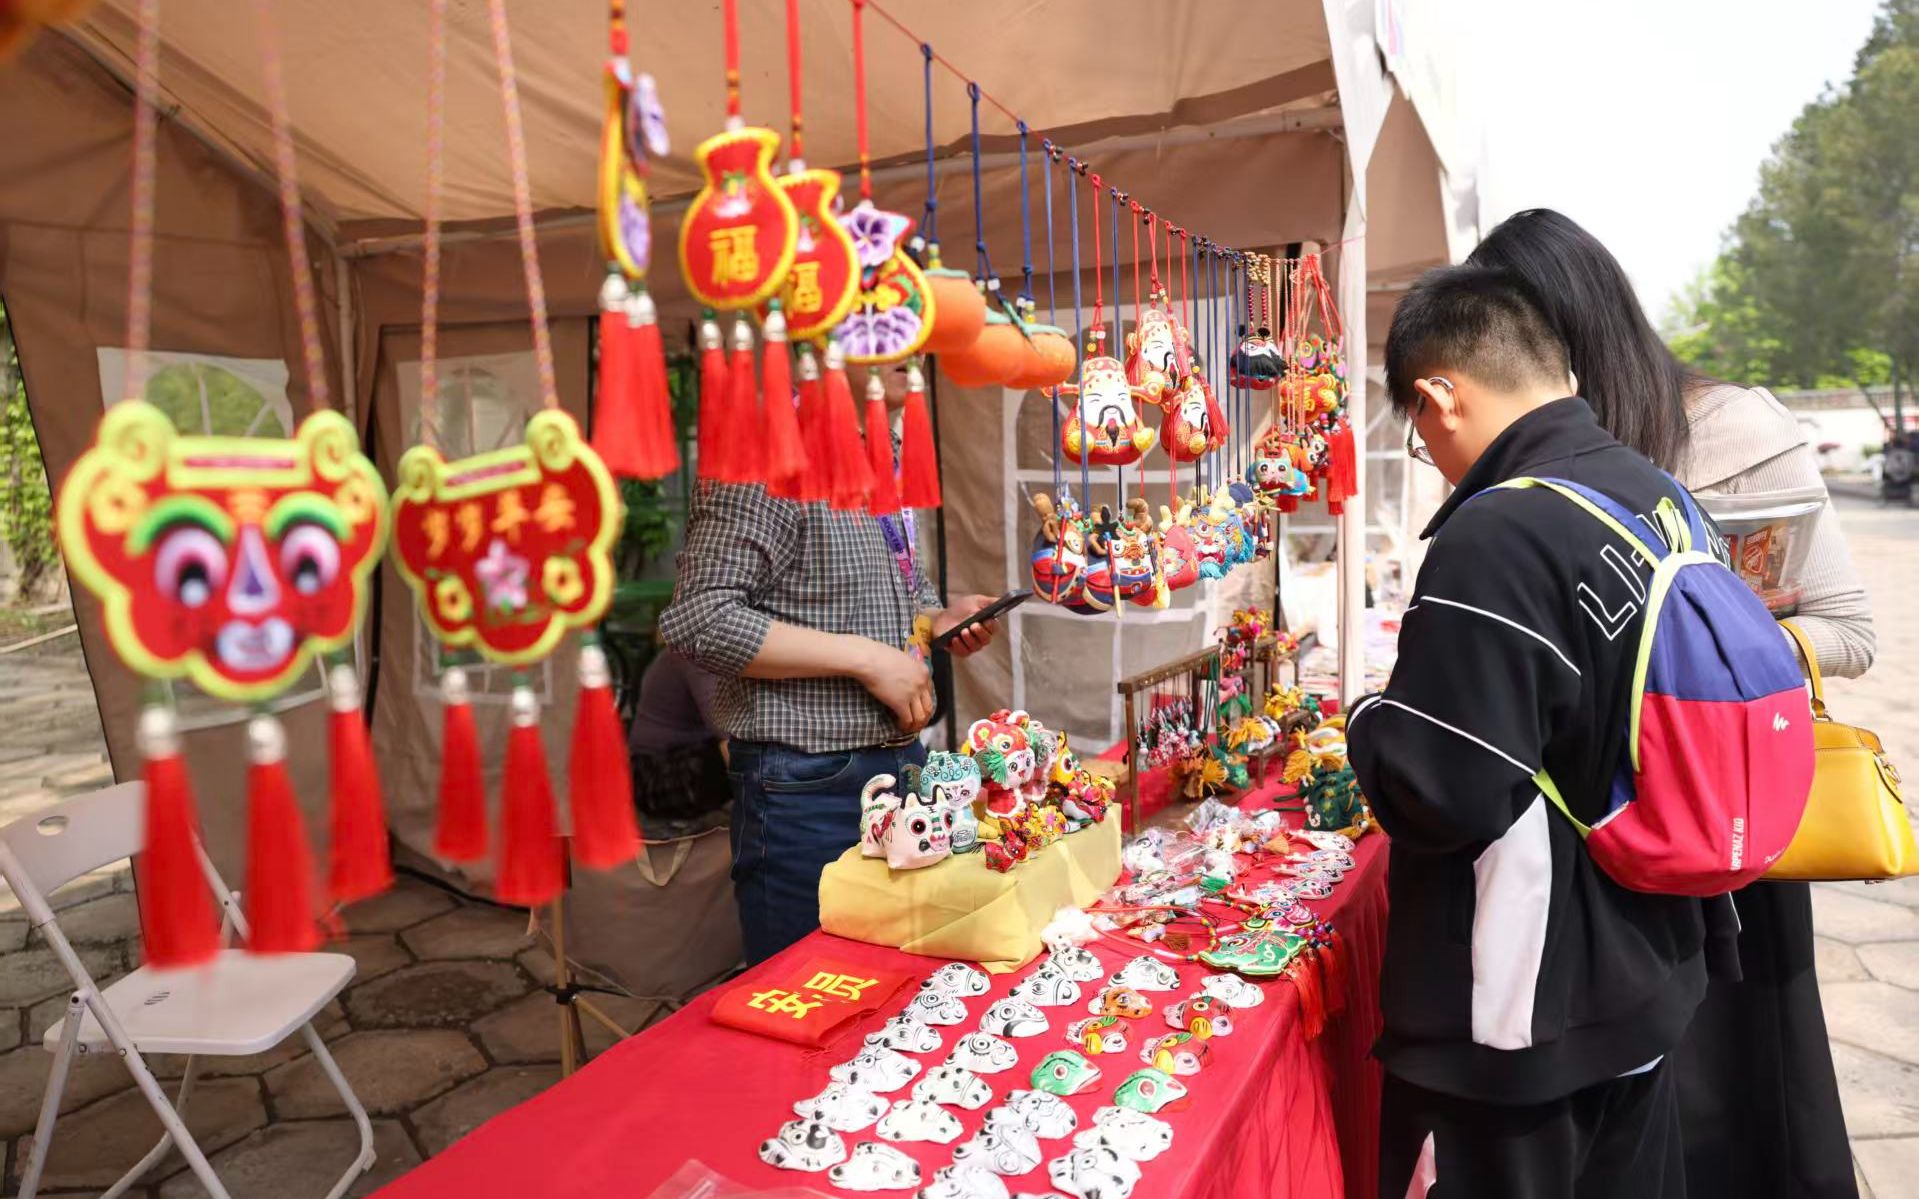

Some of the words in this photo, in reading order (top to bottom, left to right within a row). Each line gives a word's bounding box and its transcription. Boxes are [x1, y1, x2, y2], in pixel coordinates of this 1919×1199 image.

[709, 225, 759, 287] 福
[785, 261, 823, 318] 福
[1733, 817, 1744, 833] KID
